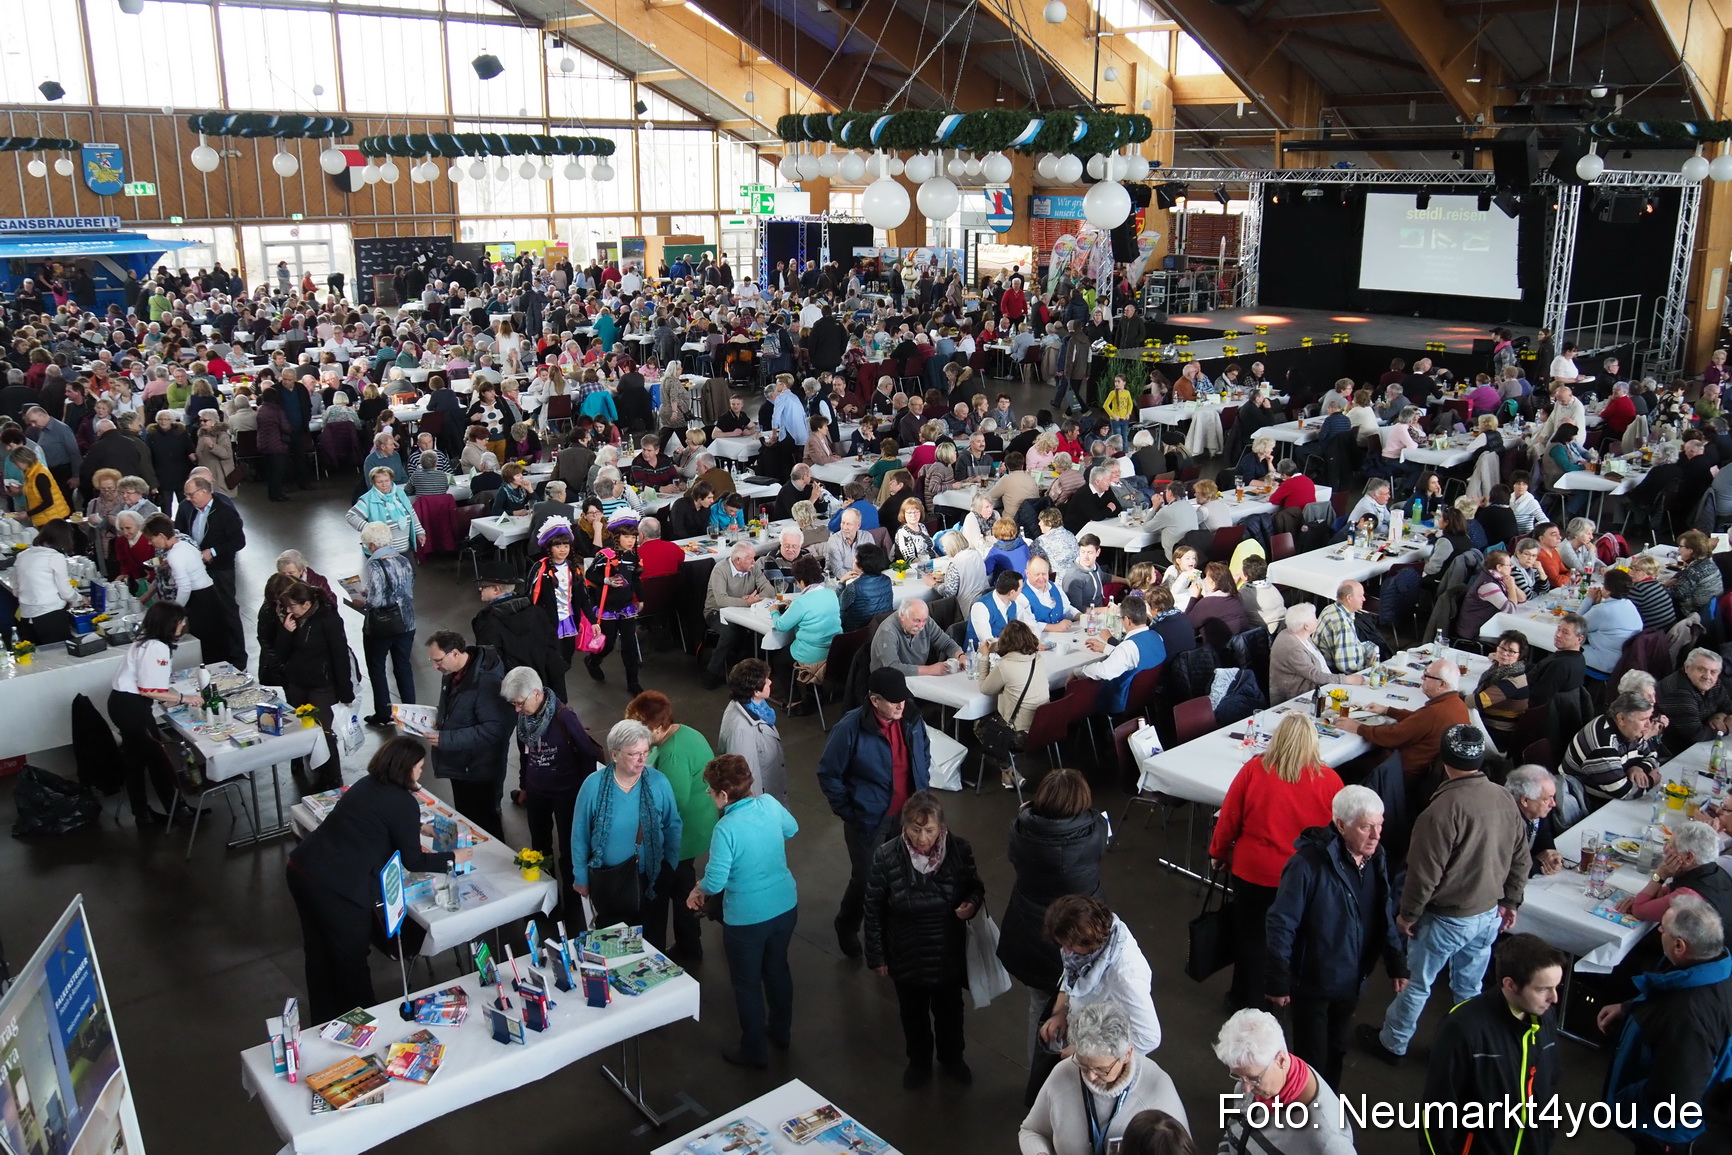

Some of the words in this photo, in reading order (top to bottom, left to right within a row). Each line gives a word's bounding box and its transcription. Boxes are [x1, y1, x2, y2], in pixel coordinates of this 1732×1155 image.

[0, 218, 105, 230] GANSBRAUEREI
[1406, 206, 1487, 221] steidl.reisen
[55, 957, 88, 1009] FALKENSTEINER
[0, 1014, 19, 1047] rag
[0, 1048, 20, 1085] ava
